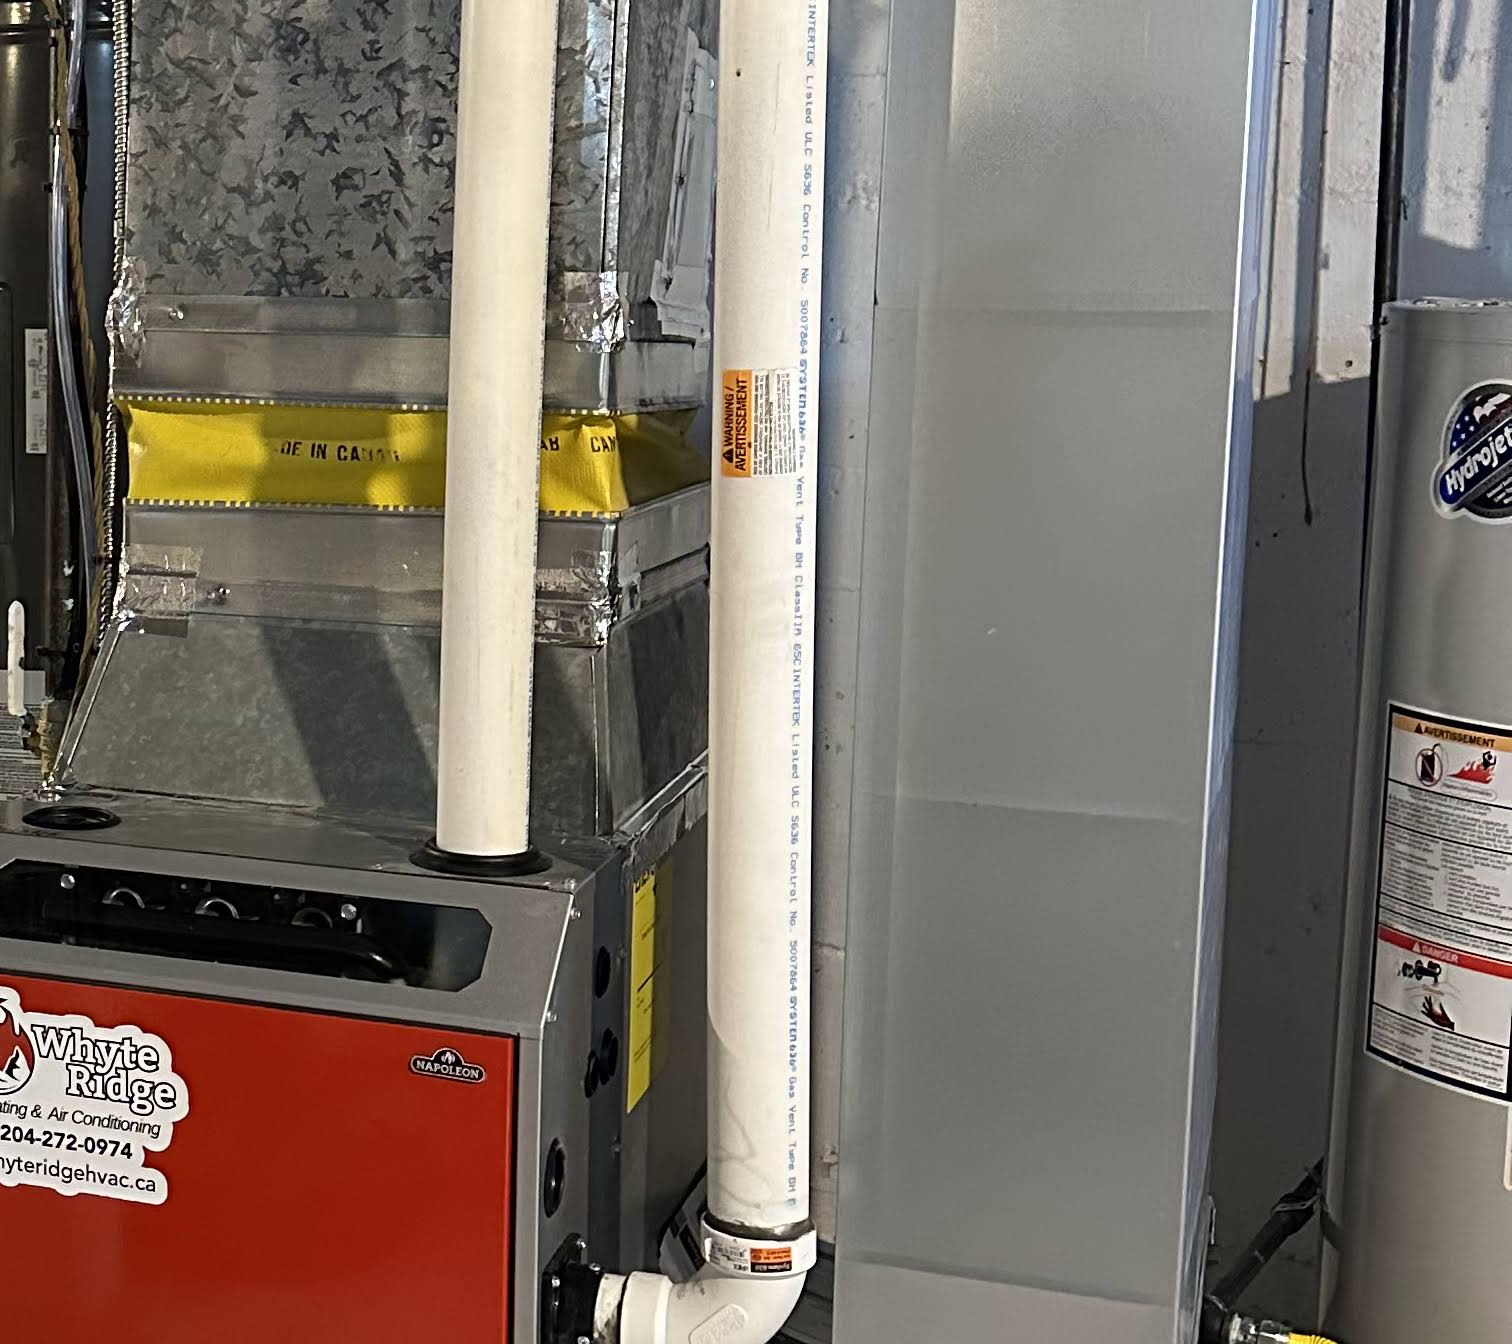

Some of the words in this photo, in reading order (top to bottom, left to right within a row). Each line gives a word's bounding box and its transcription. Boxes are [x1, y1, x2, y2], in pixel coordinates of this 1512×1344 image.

[806, 5, 816, 66] INTERTEK
[805, 75, 813, 123] Listed
[804, 132, 813, 155] ULC
[803, 164, 812, 195] S636
[802, 205, 811, 258] Control
[800, 300, 809, 354] 5007864
[723, 392, 734, 447] WARNING
[735, 379, 748, 471] AVERTISSEMENT
[311, 443, 327, 459] IN
[1446, 425, 1512, 496] Hydrojet
[796, 477, 805, 505] Vent
[794, 515, 803, 544] Type
[795, 553, 803, 567] BH
[792, 669, 801, 726] INTERTEK
[1424, 726, 1495, 748] AVERTISSEMENT
[791, 734, 800, 778] Listed
[791, 786, 800, 808] ULC
[790, 816, 799, 844] S636
[789, 852, 798, 902] Control
[789, 940, 798, 991] 5007864
[1422, 944, 1458, 963] DANGER
[31, 1024, 159, 1074] Whyte
[416, 1060, 479, 1078] NAPOLEON
[66, 1063, 176, 1116] Ridge
[788, 1077, 797, 1098] Gas
[31, 1104, 42, 1118] &
[48, 1107, 69, 1122] Air
[71, 1110, 161, 1139] Conditioning
[788, 1105, 797, 1134] Vent
[0, 1124, 133, 1159] 204-272-0974
